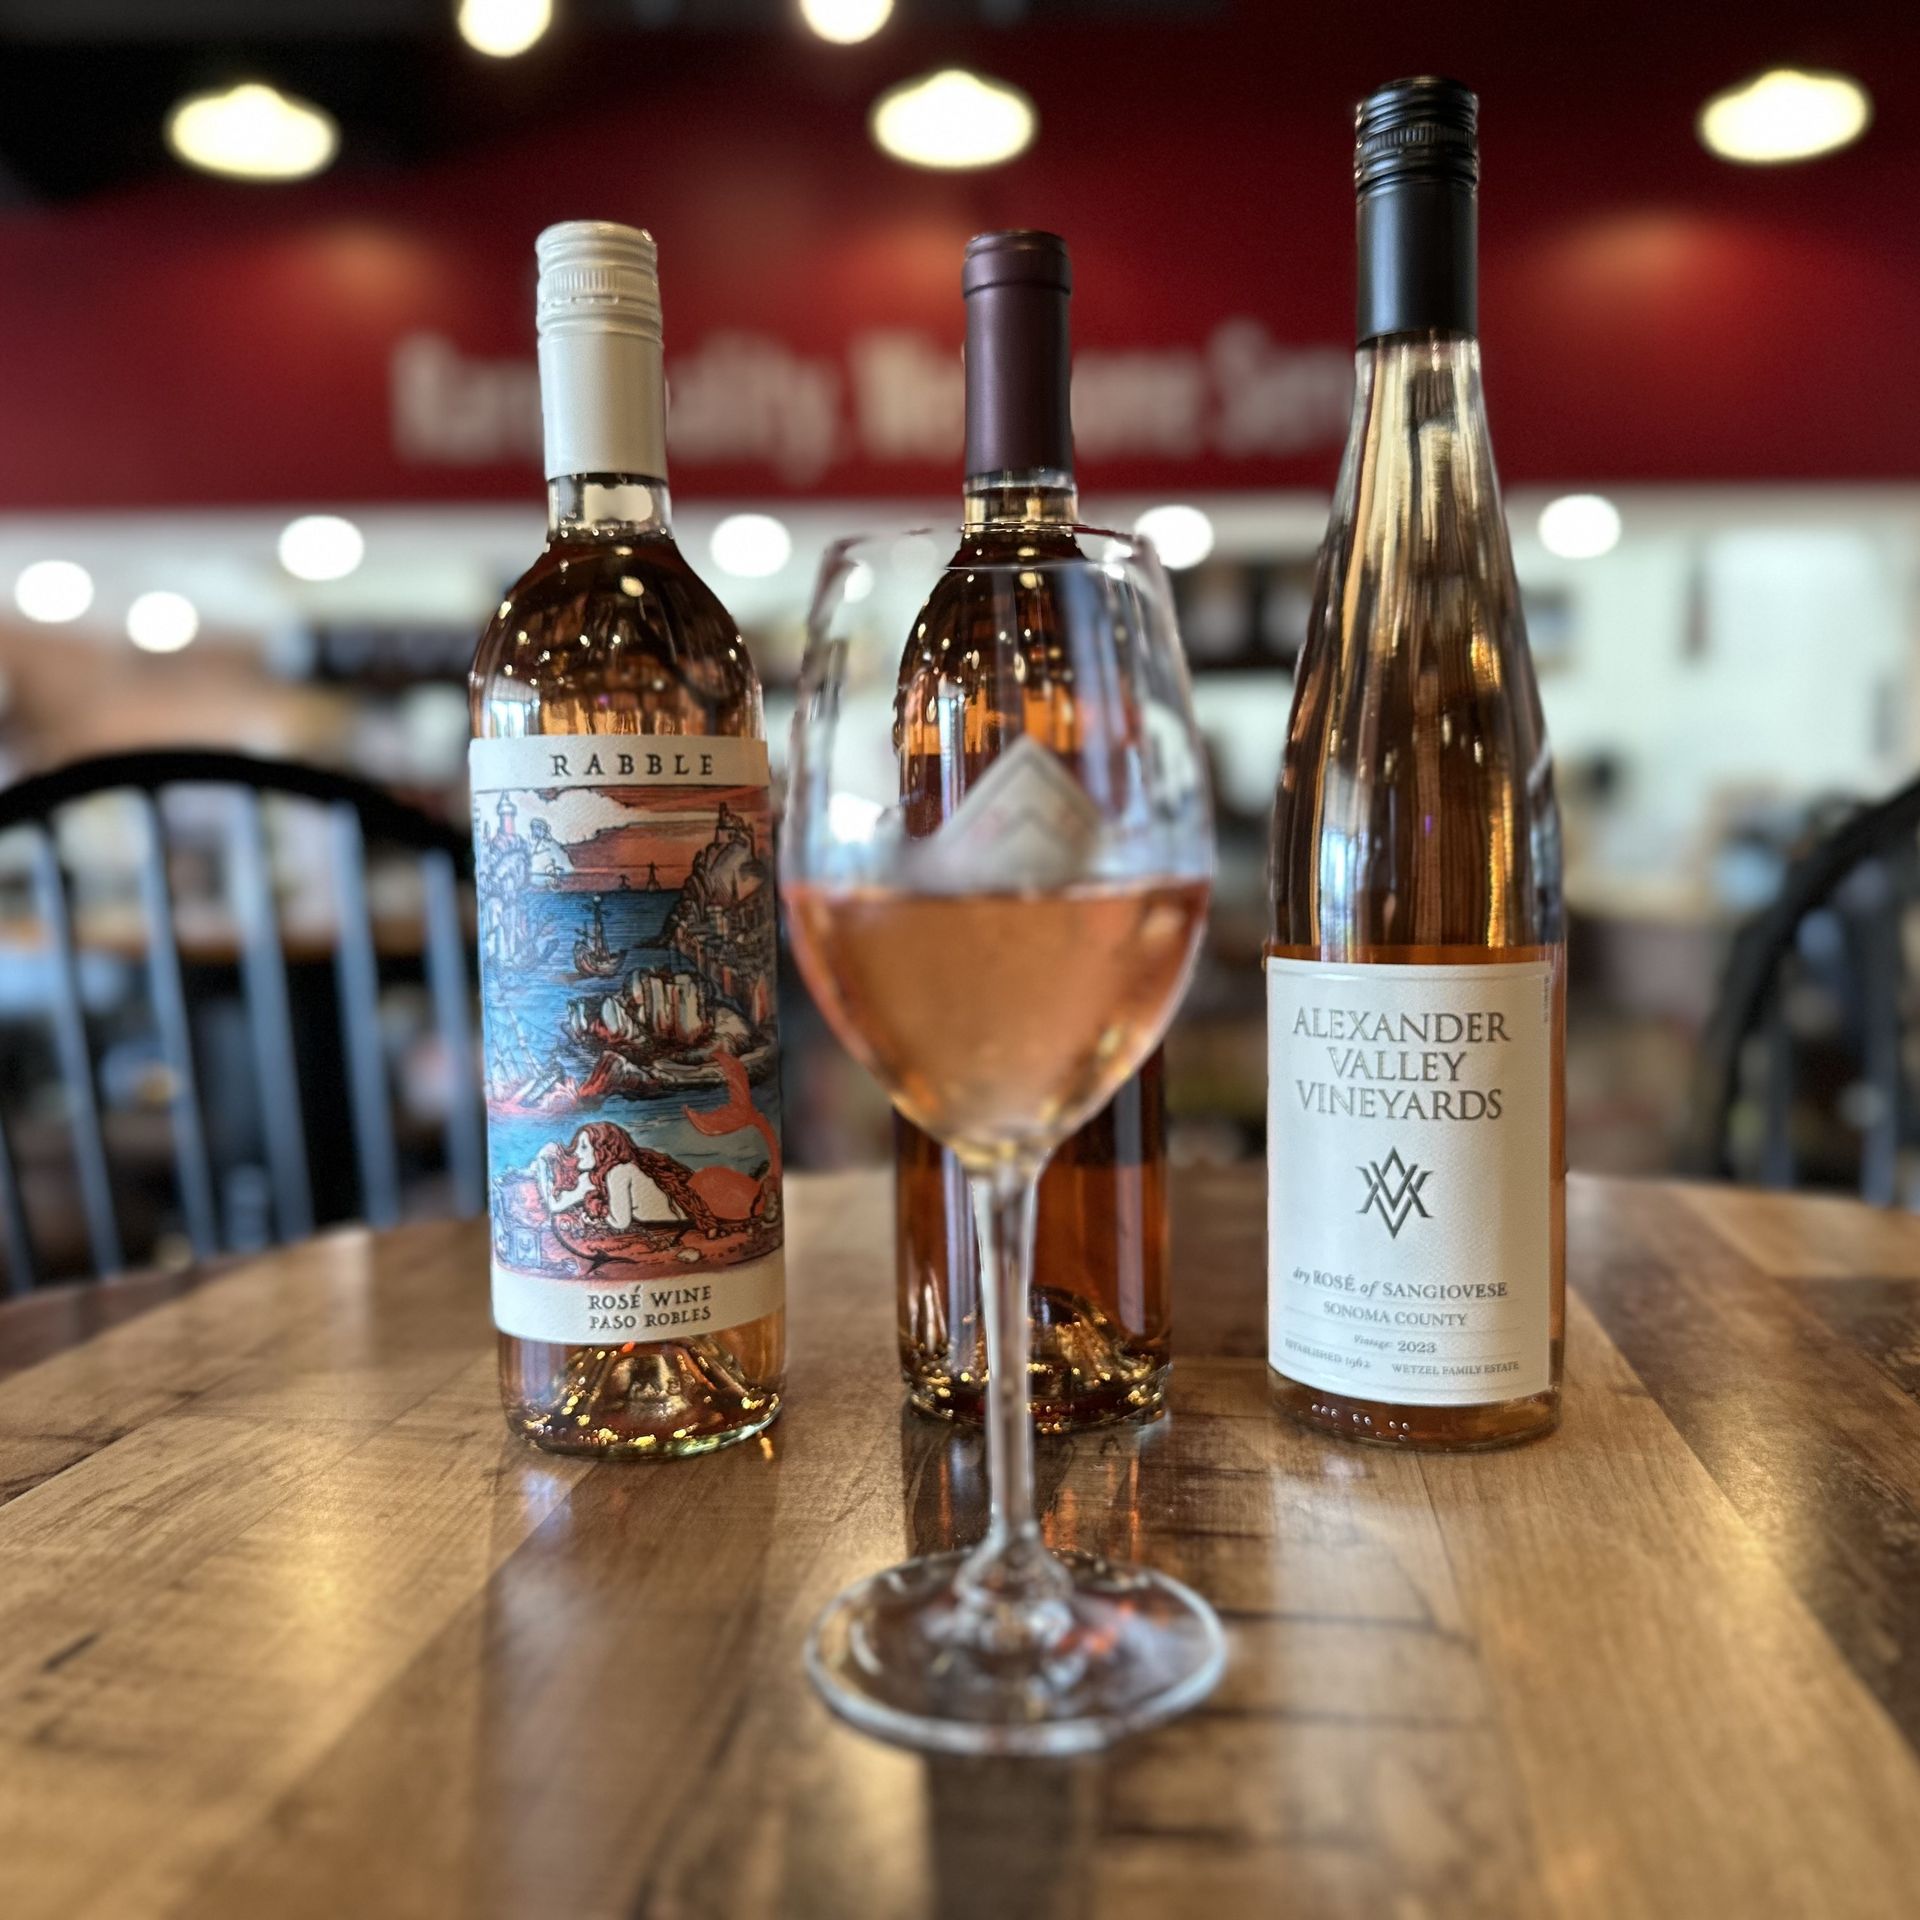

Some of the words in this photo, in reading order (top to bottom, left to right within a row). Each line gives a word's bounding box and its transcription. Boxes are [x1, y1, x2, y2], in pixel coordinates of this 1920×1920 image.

[551, 753, 713, 777] RABBLE
[1292, 1006, 1511, 1043] ALEXANDER
[1327, 1046, 1467, 1082] VALLEY
[1295, 1079, 1503, 1121] VINEYARDS
[1292, 1266, 1310, 1284] dry
[1313, 1270, 1355, 1291] ROSÉ
[1360, 1280, 1382, 1298] of
[1383, 1281, 1508, 1299] SANGIOVESE
[588, 1285, 642, 1310] ROSÉ
[651, 1285, 712, 1305] WINE
[589, 1314, 637, 1330] PASO
[644, 1306, 712, 1328] ROBLES
[1324, 1300, 1391, 1323] SONOMA
[1394, 1312, 1468, 1327] COUNTY
[1397, 1339, 1437, 1354] 2023
[1391, 1362, 1440, 1376] WETZEL
[1442, 1363, 1482, 1376] FAMILY
[1483, 1360, 1520, 1374] ESTATE
